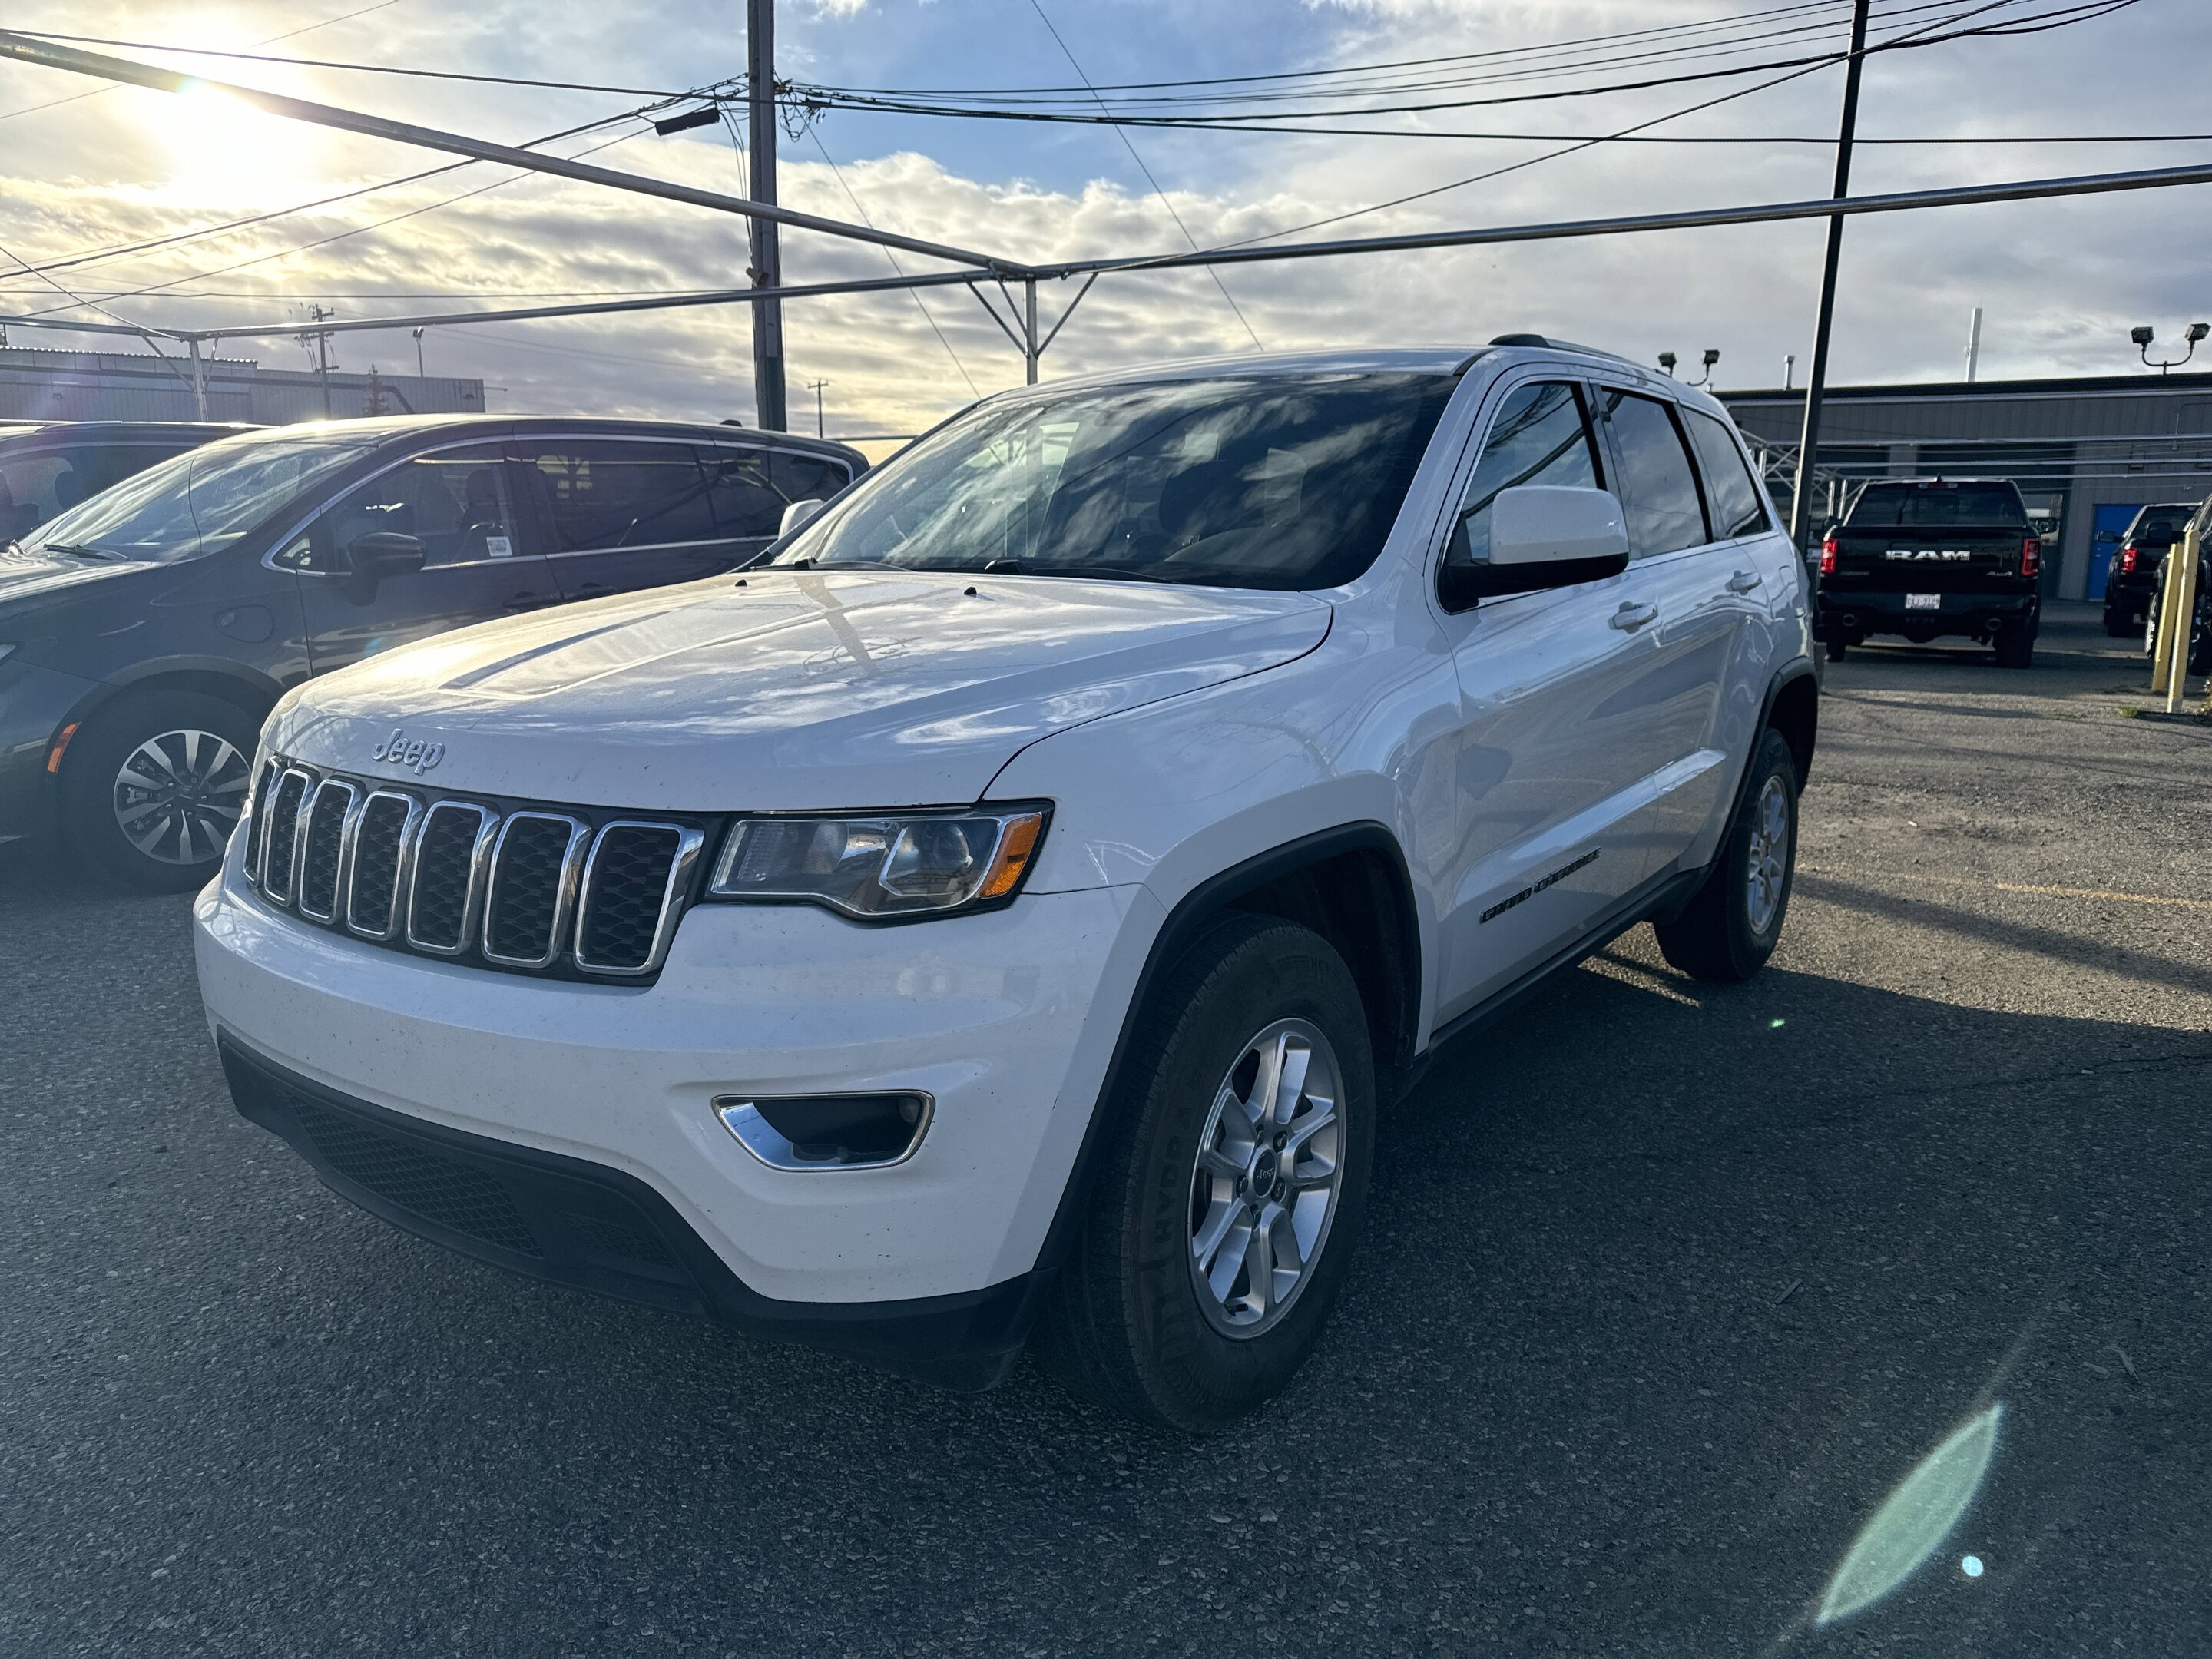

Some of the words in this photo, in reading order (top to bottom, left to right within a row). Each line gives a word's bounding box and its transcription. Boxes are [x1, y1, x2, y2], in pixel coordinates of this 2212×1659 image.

[1886, 550, 1971, 561] RAM
[371, 728, 445, 776] Jeep
[1479, 886, 1532, 923] GRAND
[1534, 846, 1601, 893] CHEROKEE
